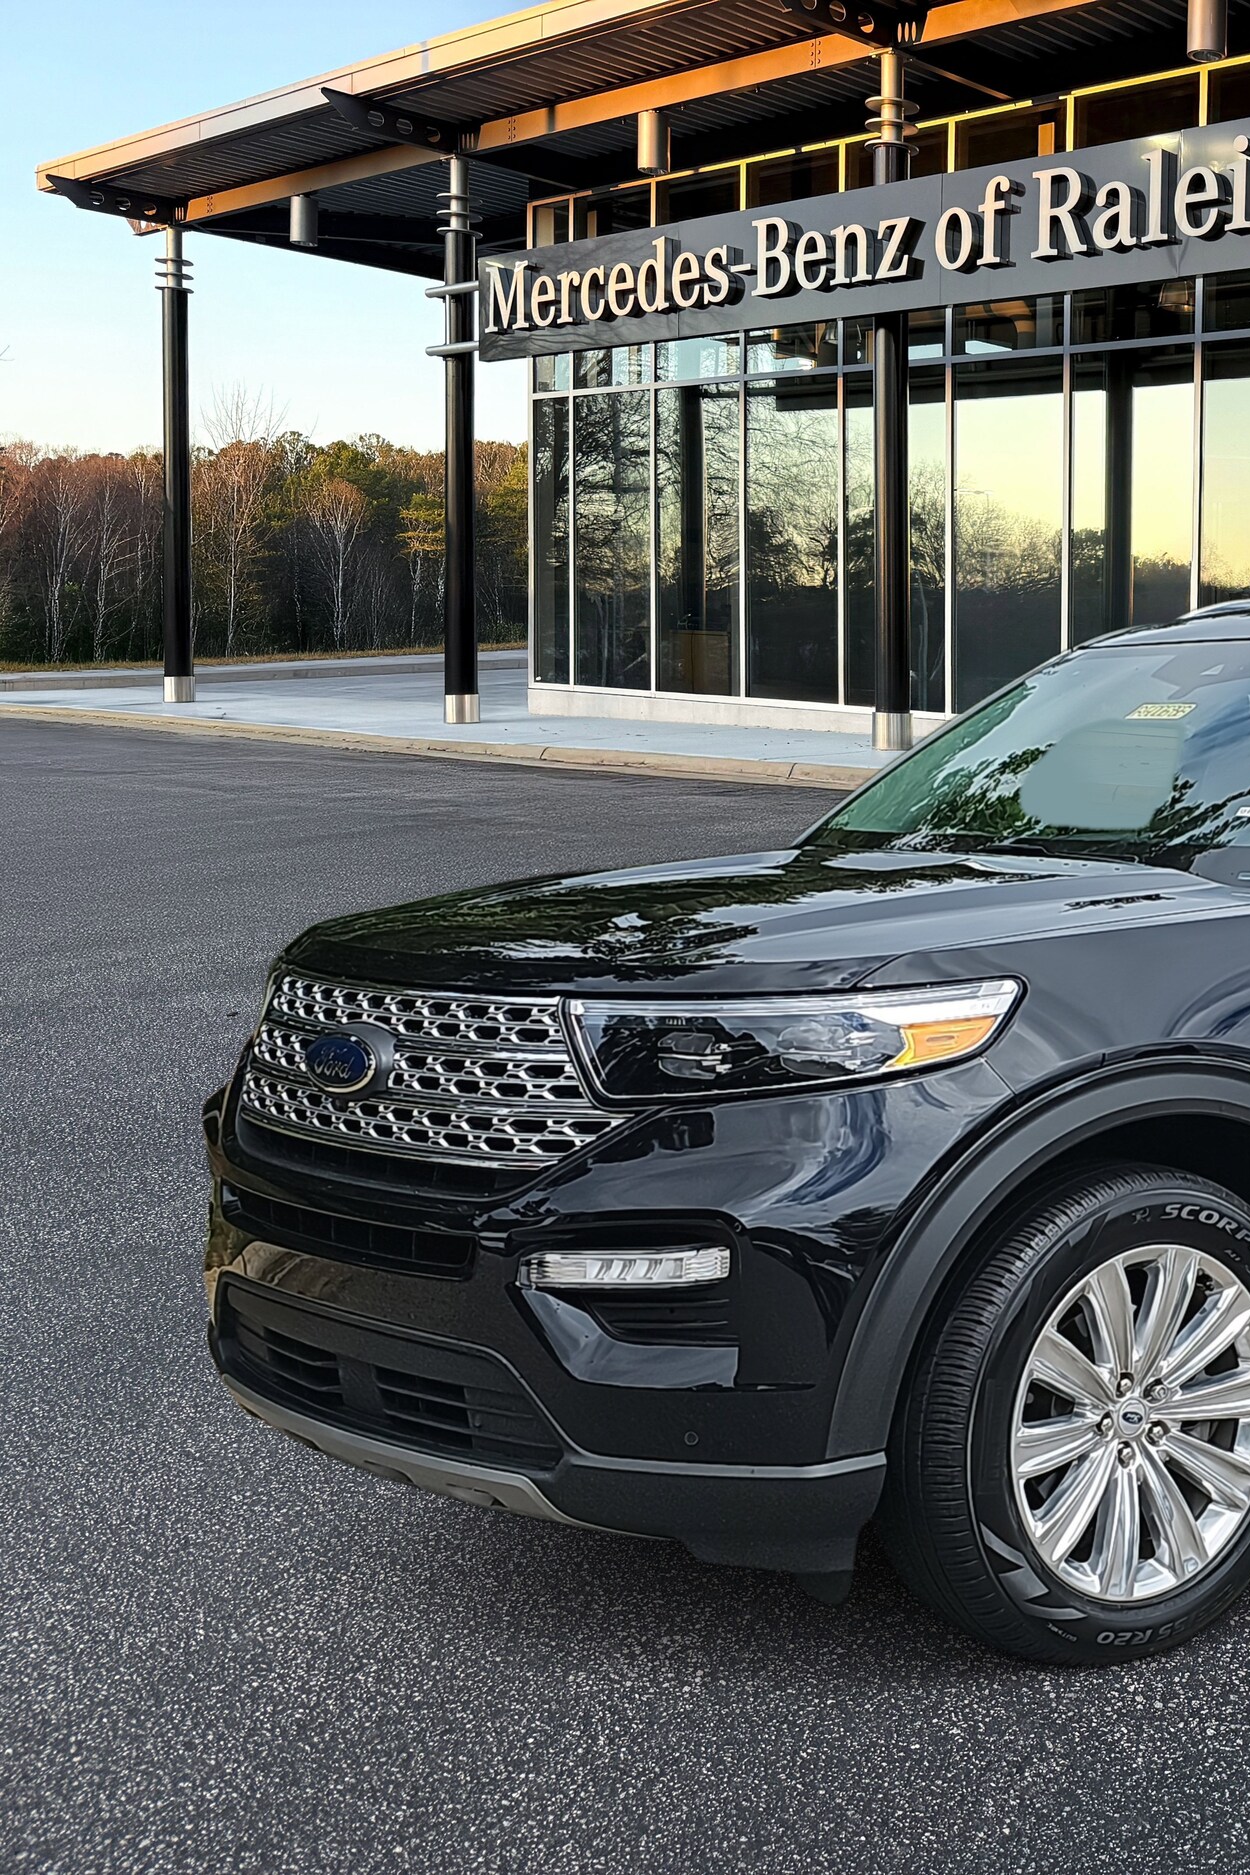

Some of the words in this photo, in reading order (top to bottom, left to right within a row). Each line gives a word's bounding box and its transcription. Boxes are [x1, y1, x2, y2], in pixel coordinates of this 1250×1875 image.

[484, 216, 917, 335] Mercedes-Benz
[935, 174, 1019, 272] of
[314, 1046, 355, 1079] Ford
[1097, 1630, 1153, 1646] R20
